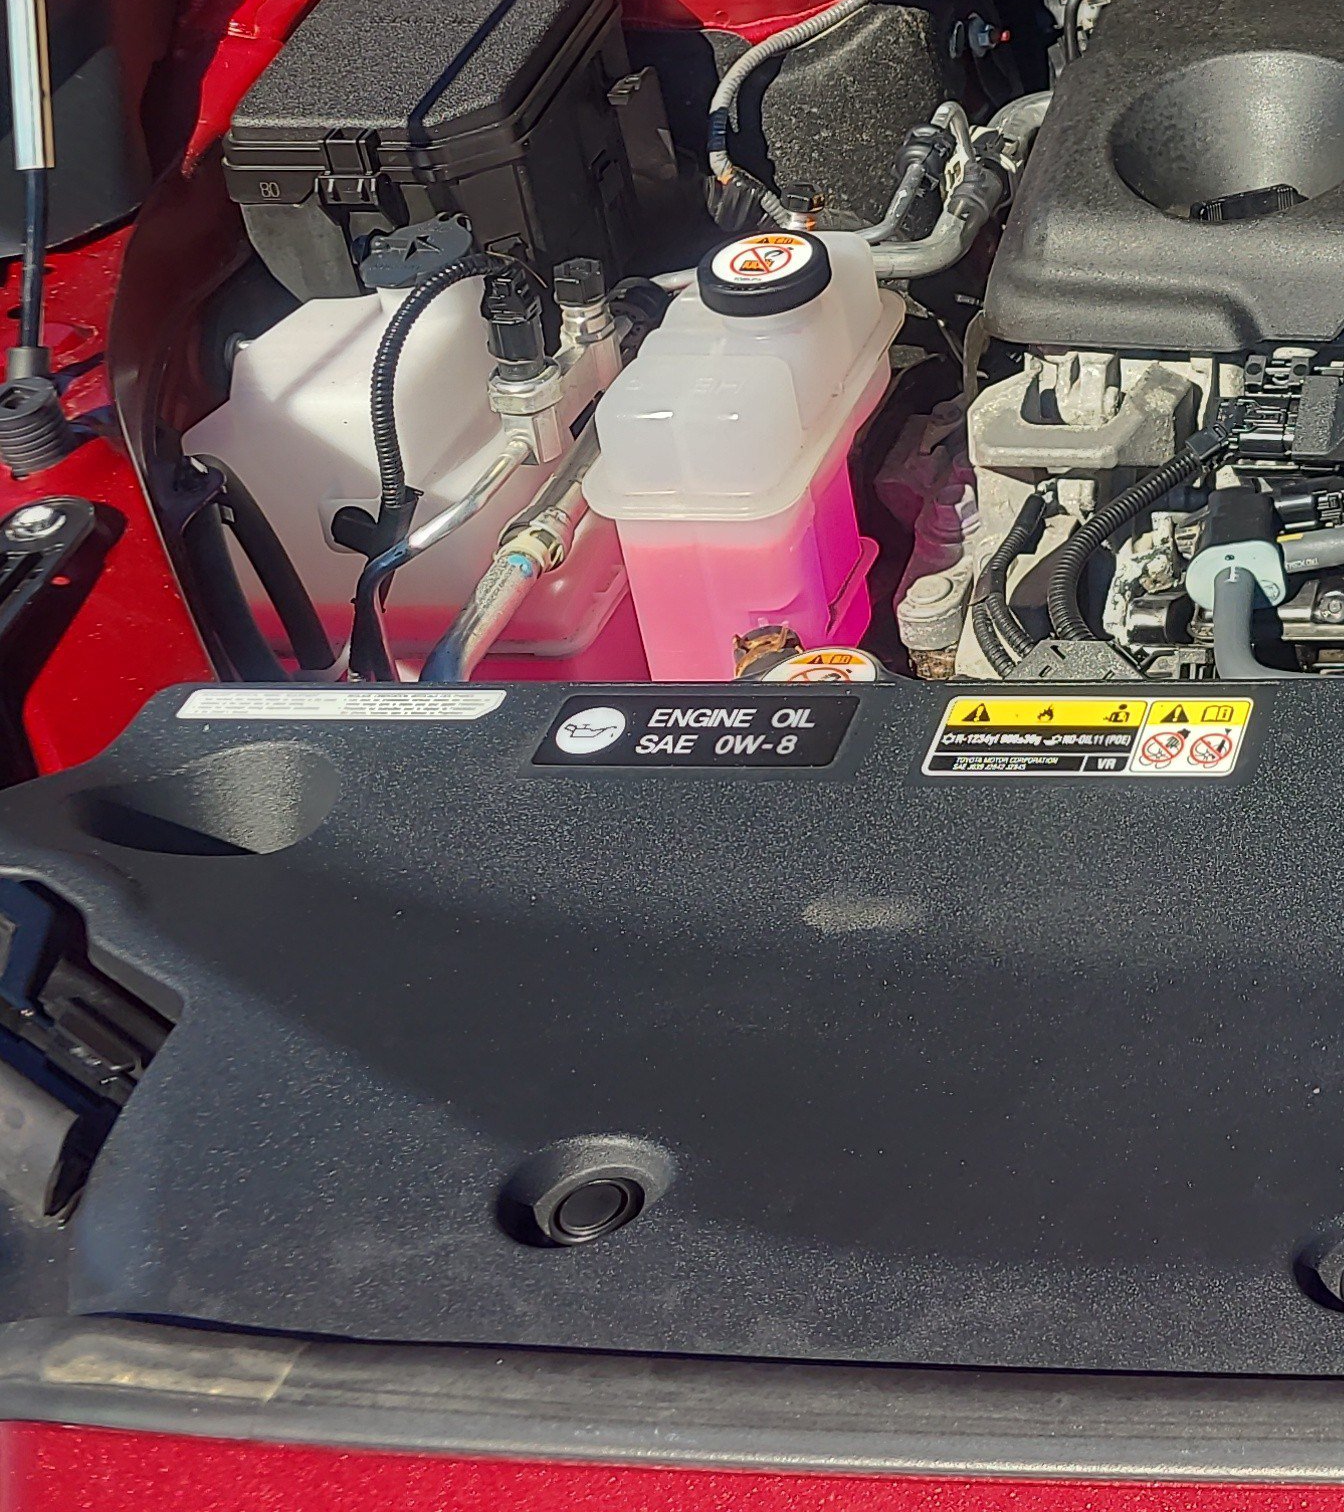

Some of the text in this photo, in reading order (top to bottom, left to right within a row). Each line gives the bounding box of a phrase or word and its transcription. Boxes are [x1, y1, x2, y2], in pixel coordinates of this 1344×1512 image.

[648, 708, 816, 729] ENGINE OIL
[635, 735, 799, 755] SAE 0W-8
[1104, 734, 1131, 746] (POE)
[1097, 758, 1117, 770] VR
